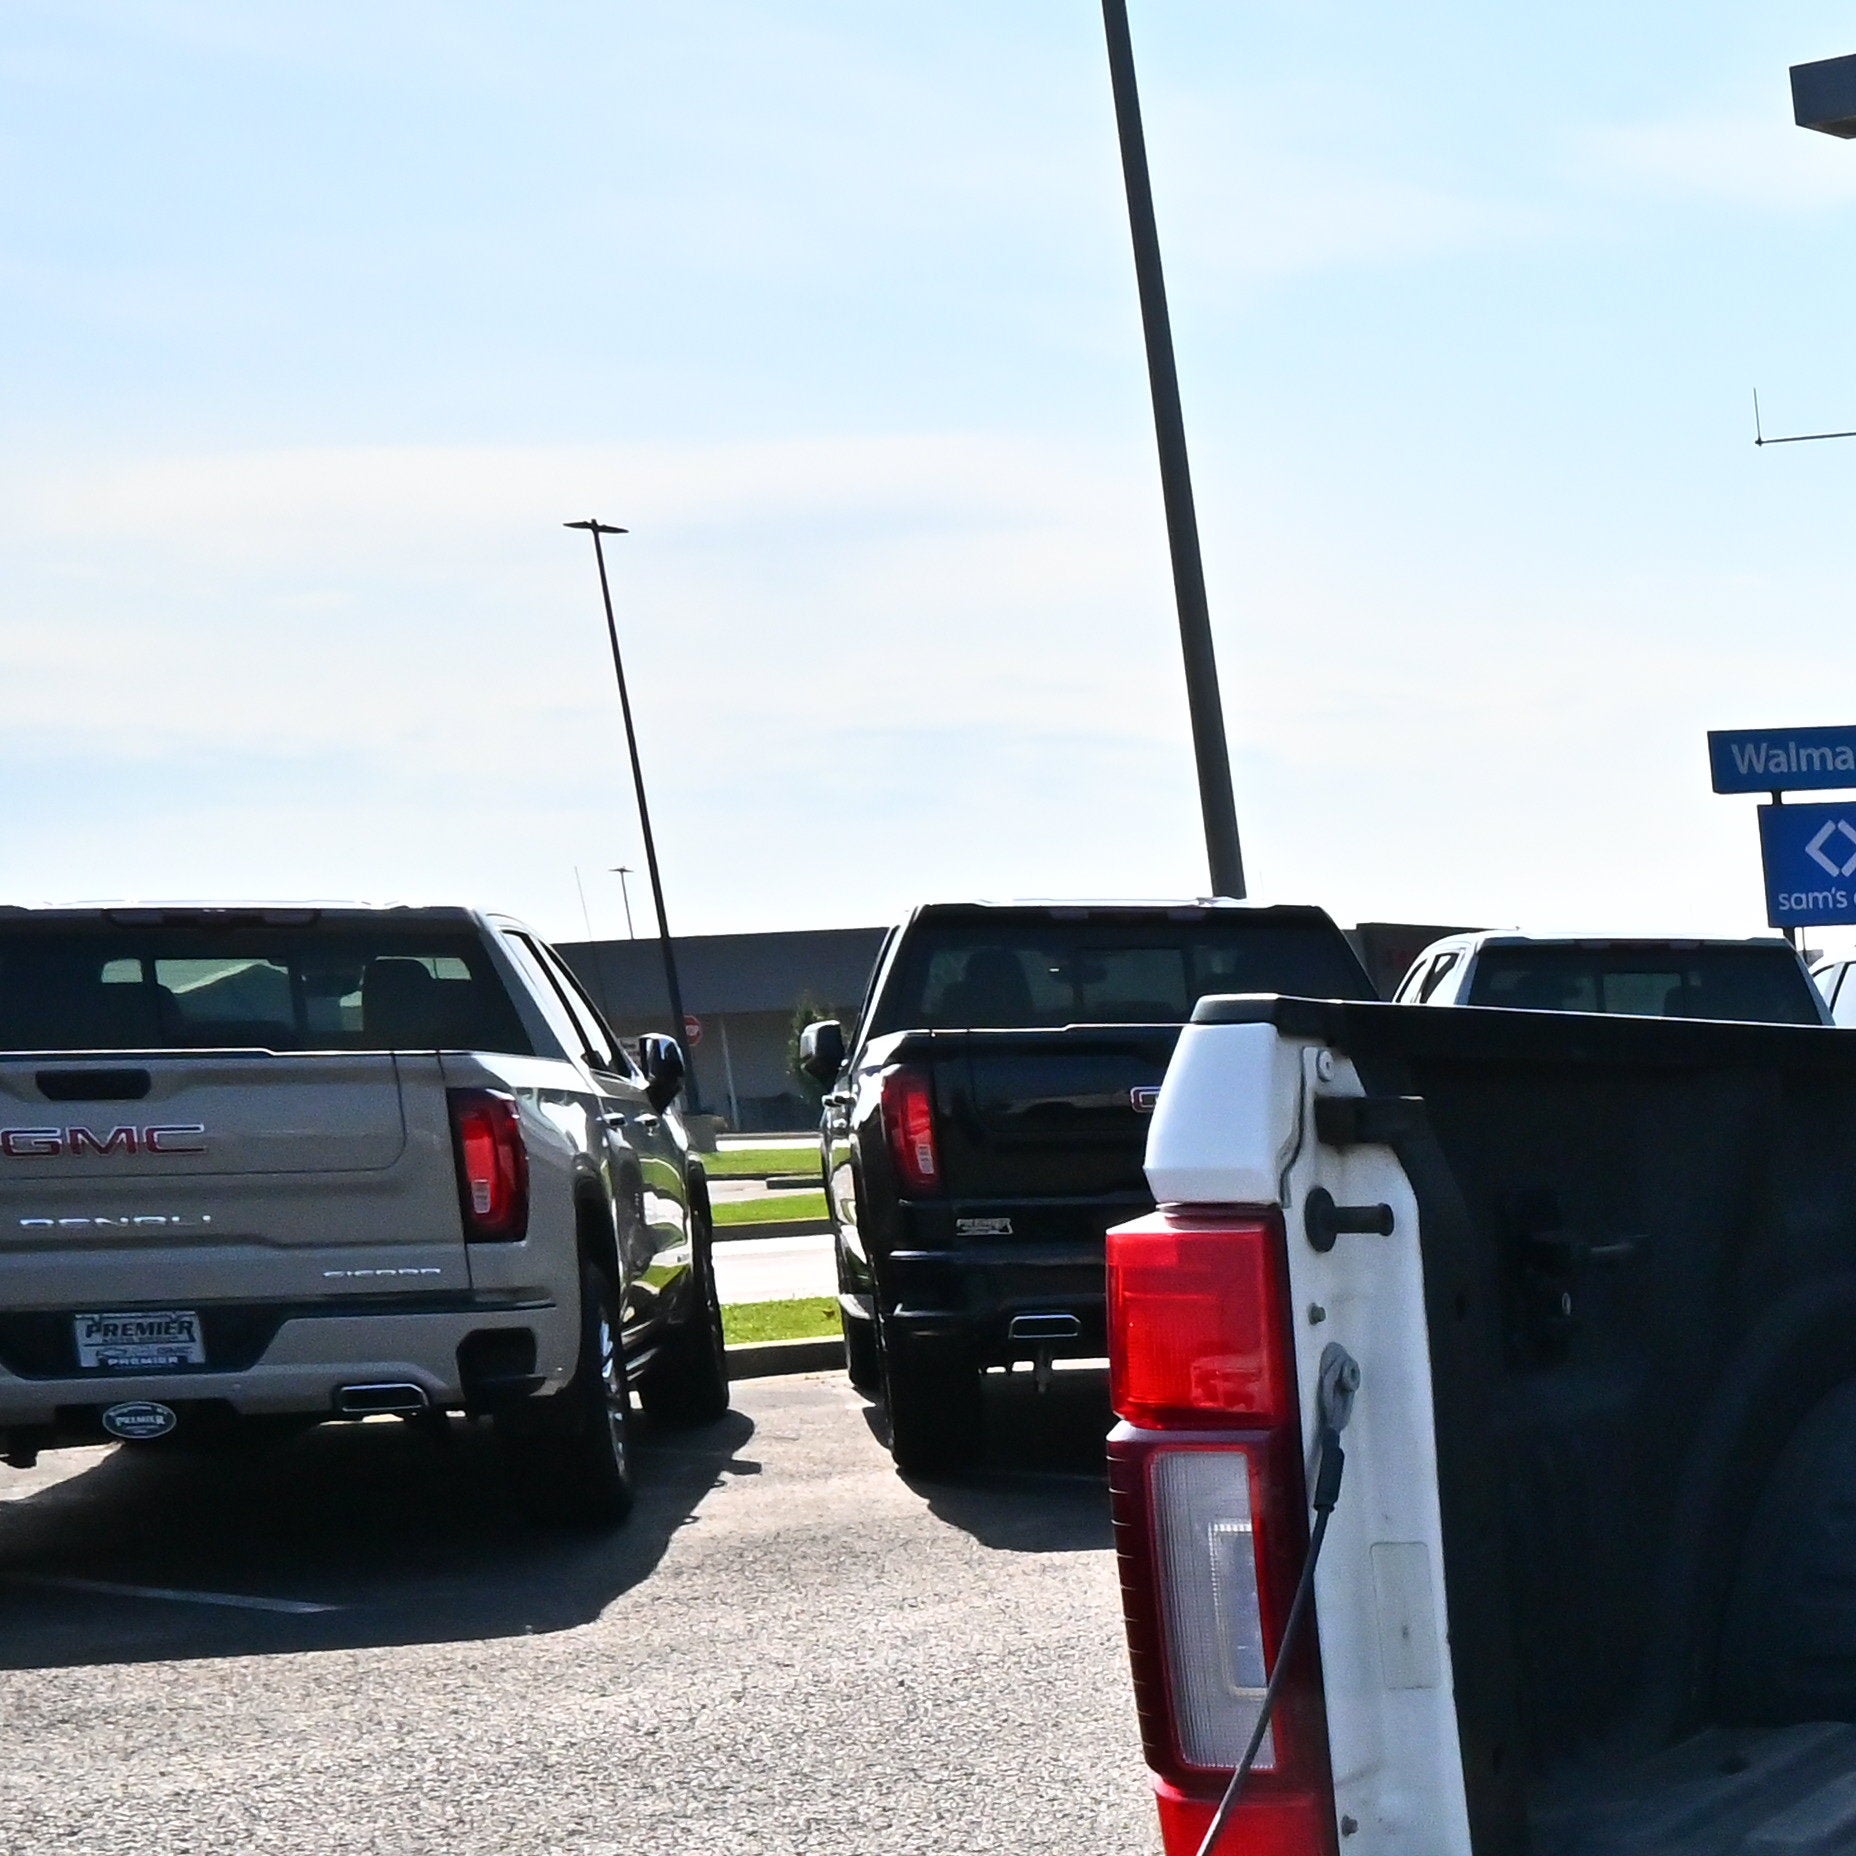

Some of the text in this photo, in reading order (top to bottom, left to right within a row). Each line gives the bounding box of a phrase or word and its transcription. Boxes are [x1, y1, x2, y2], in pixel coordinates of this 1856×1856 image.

[1778, 886, 1849, 911] sam's
[0, 1123, 208, 1157] GMC
[84, 1318, 196, 1343] PREMIER
